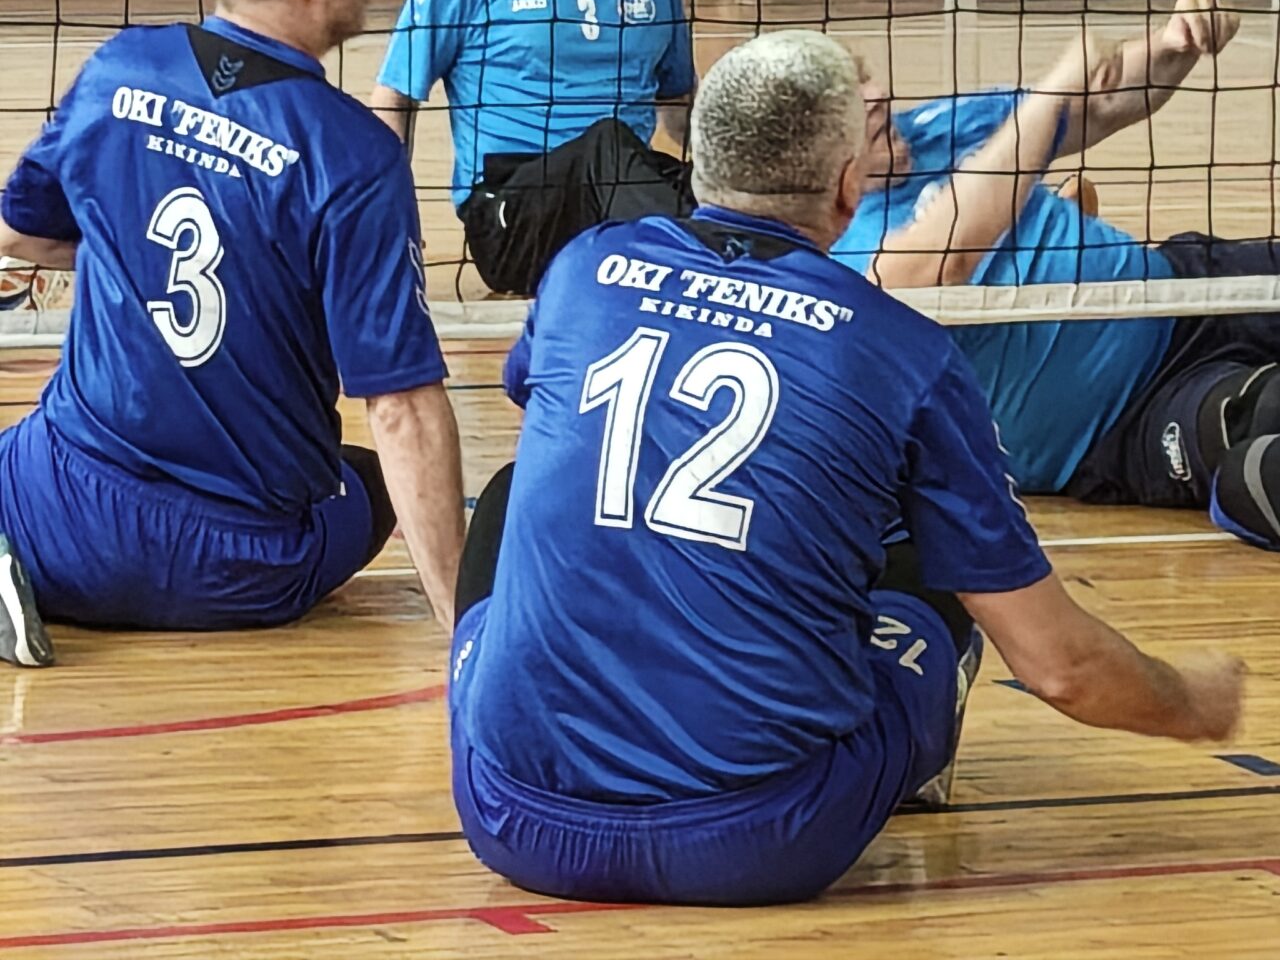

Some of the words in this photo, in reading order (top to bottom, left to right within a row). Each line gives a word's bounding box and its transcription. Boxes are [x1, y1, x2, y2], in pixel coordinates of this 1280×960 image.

[111, 86, 167, 127] OKI
[146, 134, 243, 178] KIKINDA
[146, 186, 227, 368] 3
[596, 254, 673, 291] OKI
[638, 297, 773, 338] KIKINDA
[578, 326, 780, 552] 12
